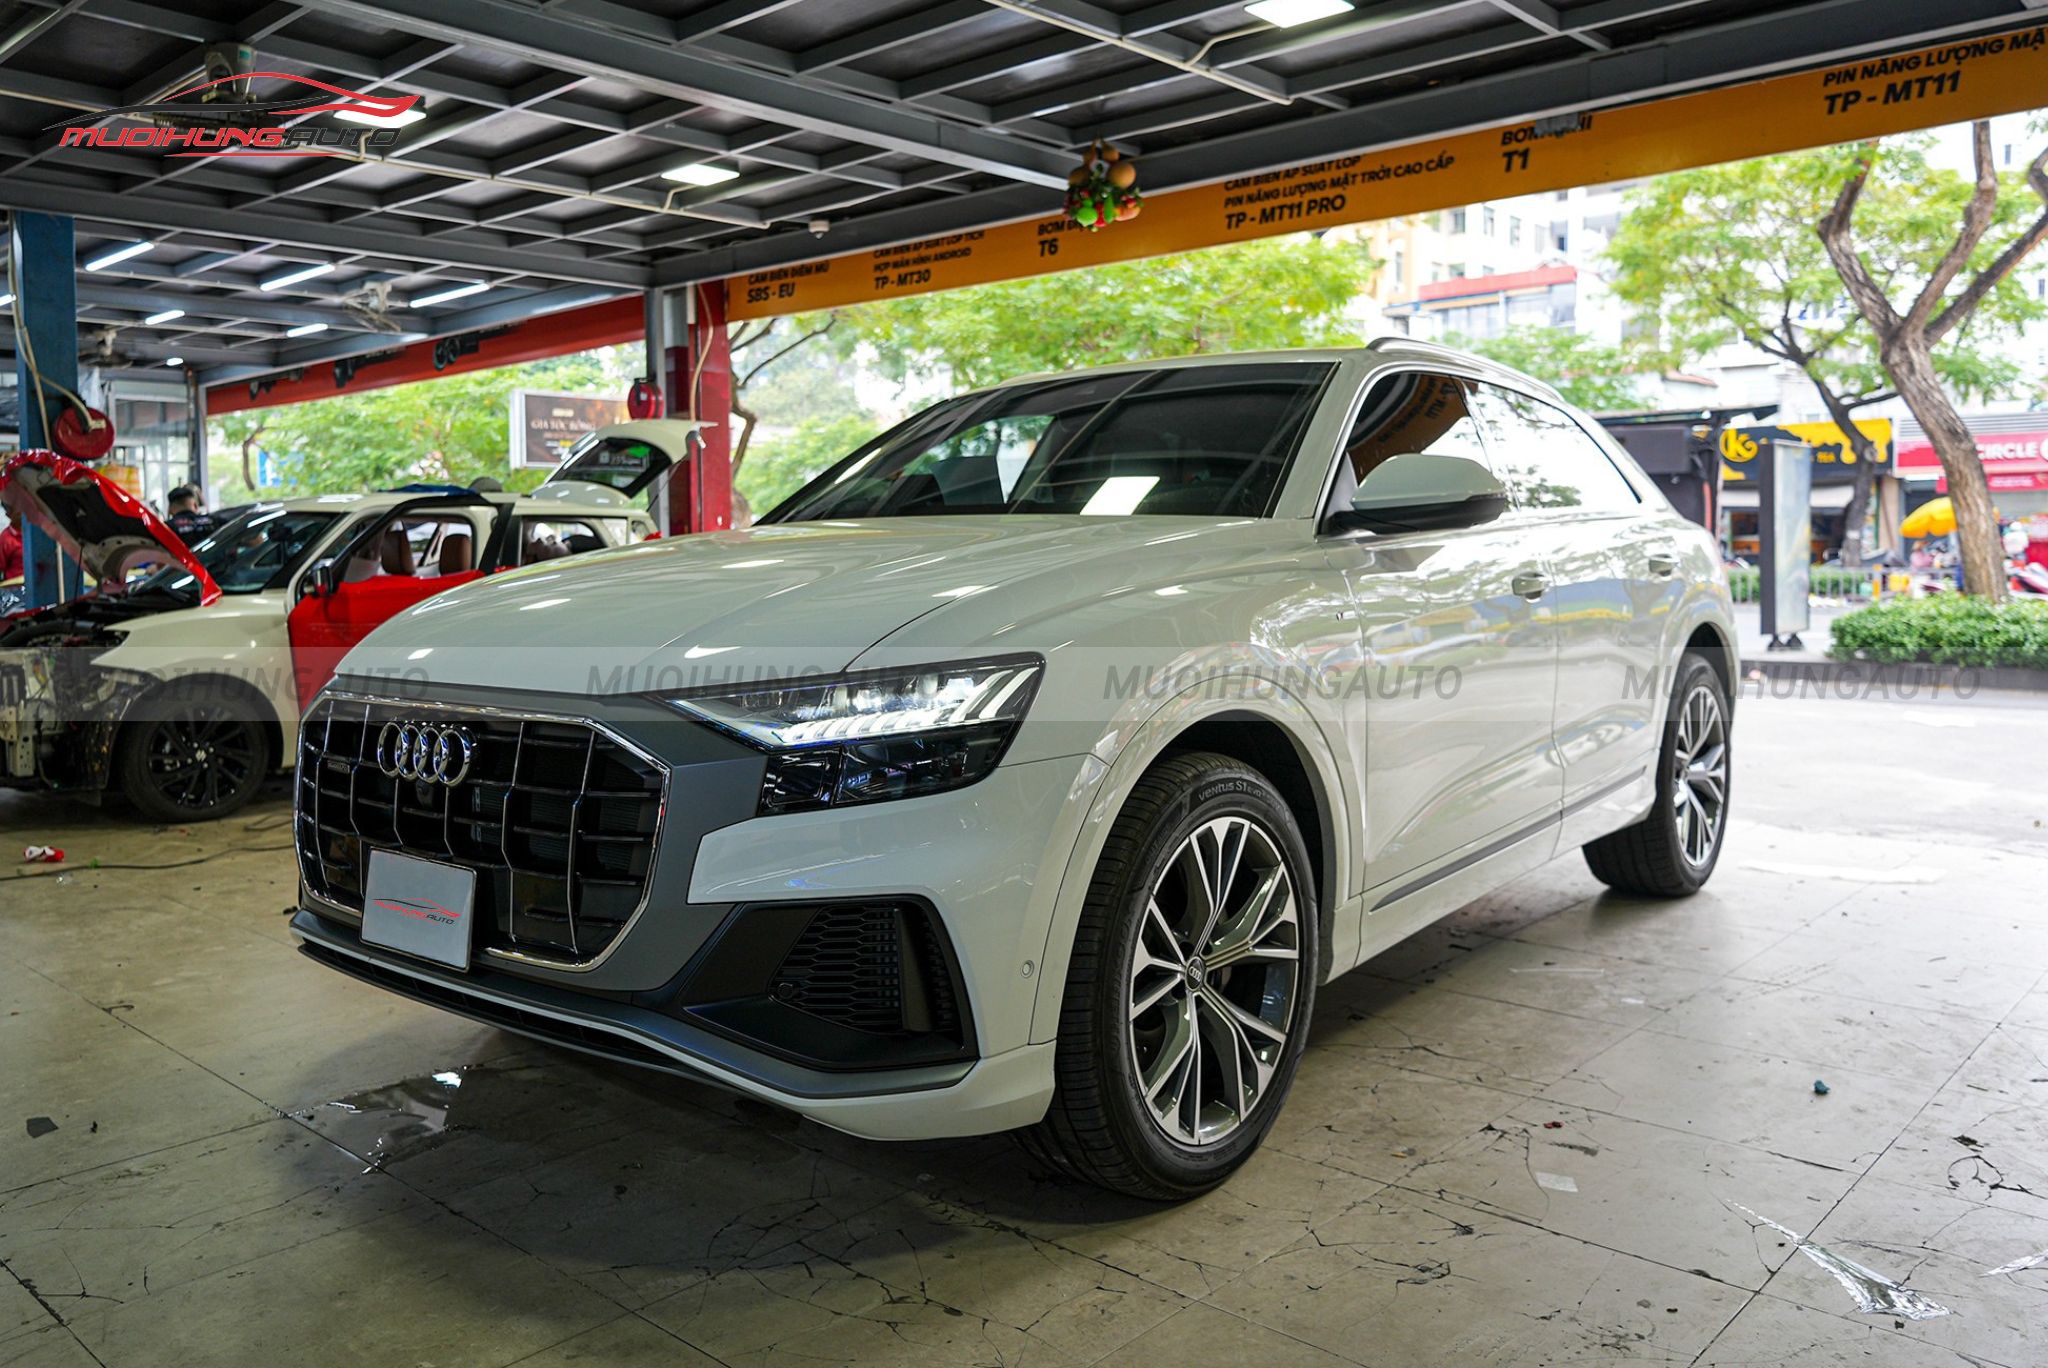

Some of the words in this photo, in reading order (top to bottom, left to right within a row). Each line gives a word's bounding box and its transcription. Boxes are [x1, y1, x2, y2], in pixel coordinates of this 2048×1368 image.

[1823, 68, 1857, 87] PIN
[1860, 56, 1921, 79] NĂNG
[1925, 39, 2006, 65] LƯỢNG
[2008, 27, 2048, 51] MẶ
[1824, 90, 1862, 115] TP
[1882, 70, 1960, 105] MT11
[1502, 147, 1530, 173] T1
[1224, 195, 1244, 209] PIN
[1393, 161, 1423, 178] CAO
[1225, 212, 1247, 230] TP
[1258, 201, 1303, 224] MT11
[1306, 194, 1346, 216] PRO
[1038, 237, 1059, 257] T6
[747, 286, 770, 303] SBS
[778, 282, 796, 298] EU
[874, 275, 889, 290] TP
[896, 268, 931, 287] MT30
